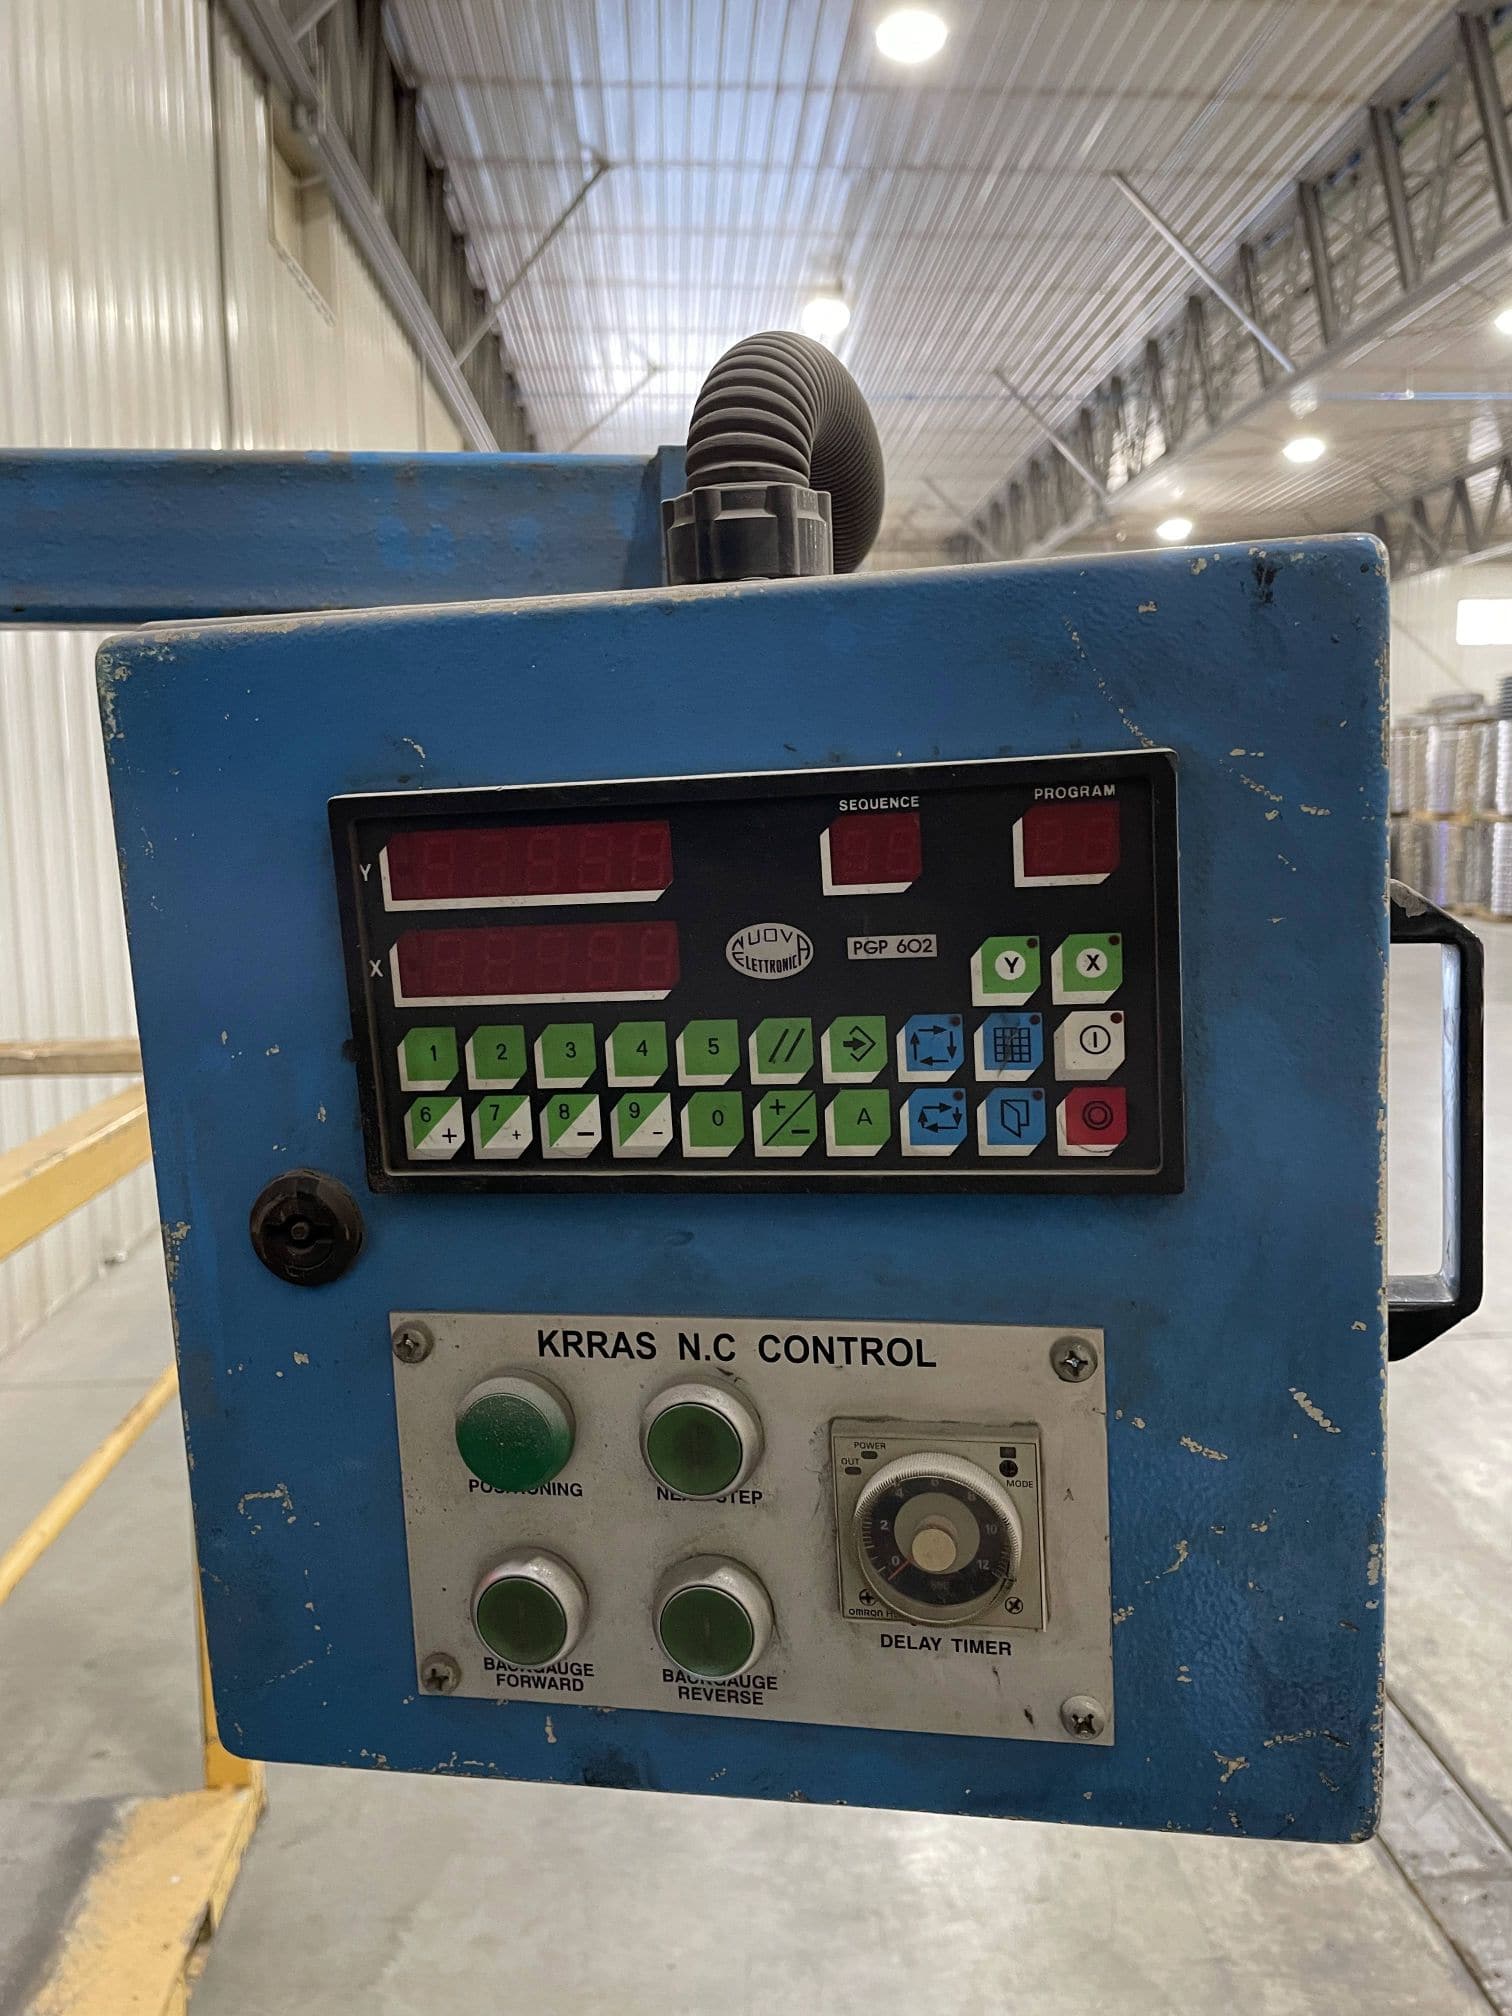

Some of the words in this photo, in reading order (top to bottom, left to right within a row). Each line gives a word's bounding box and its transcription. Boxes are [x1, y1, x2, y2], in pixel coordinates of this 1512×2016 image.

[1034, 784, 1116, 800] PROGRAM
[839, 796, 920, 812] SEQUENCE
[360, 863, 372, 882] Y
[732, 928, 811, 967] NUOVA
[853, 940, 889, 956] PGP
[896, 938, 933, 955] 602
[370, 959, 384, 978] X
[732, 951, 811, 974] ELETTRONICA
[1004, 956, 1020, 974] Y
[1086, 954, 1101, 972] X
[430, 1045, 438, 1062] 1
[496, 1043, 508, 1061] 2
[565, 1041, 577, 1059] 3
[636, 1039, 648, 1057] 4
[707, 1037, 720, 1056] 5
[420, 1106, 432, 1123] 6
[489, 1104, 500, 1121] 7
[559, 1103, 570, 1120] 8
[628, 1101, 640, 1119] 9
[711, 1109, 724, 1127] 0
[856, 1107, 873, 1126] A
[537, 1329, 657, 1360] KRRAS
[677, 1332, 736, 1362] N.C
[757, 1334, 937, 1368] CONTROL
[853, 1441, 886, 1450] POWER
[840, 1457, 860, 1465] OUT
[1006, 1479, 1034, 1489] MODE
[879, 1520, 889, 1531] 2
[985, 1523, 999, 1536] 10
[891, 1556, 901, 1567] 0
[977, 1559, 991, 1571] 12
[880, 1633, 942, 1651] DELAY
[951, 1638, 1013, 1656] TIMER
[496, 1673, 585, 1692] FORWARD
[678, 1685, 764, 1706] REVERSE
